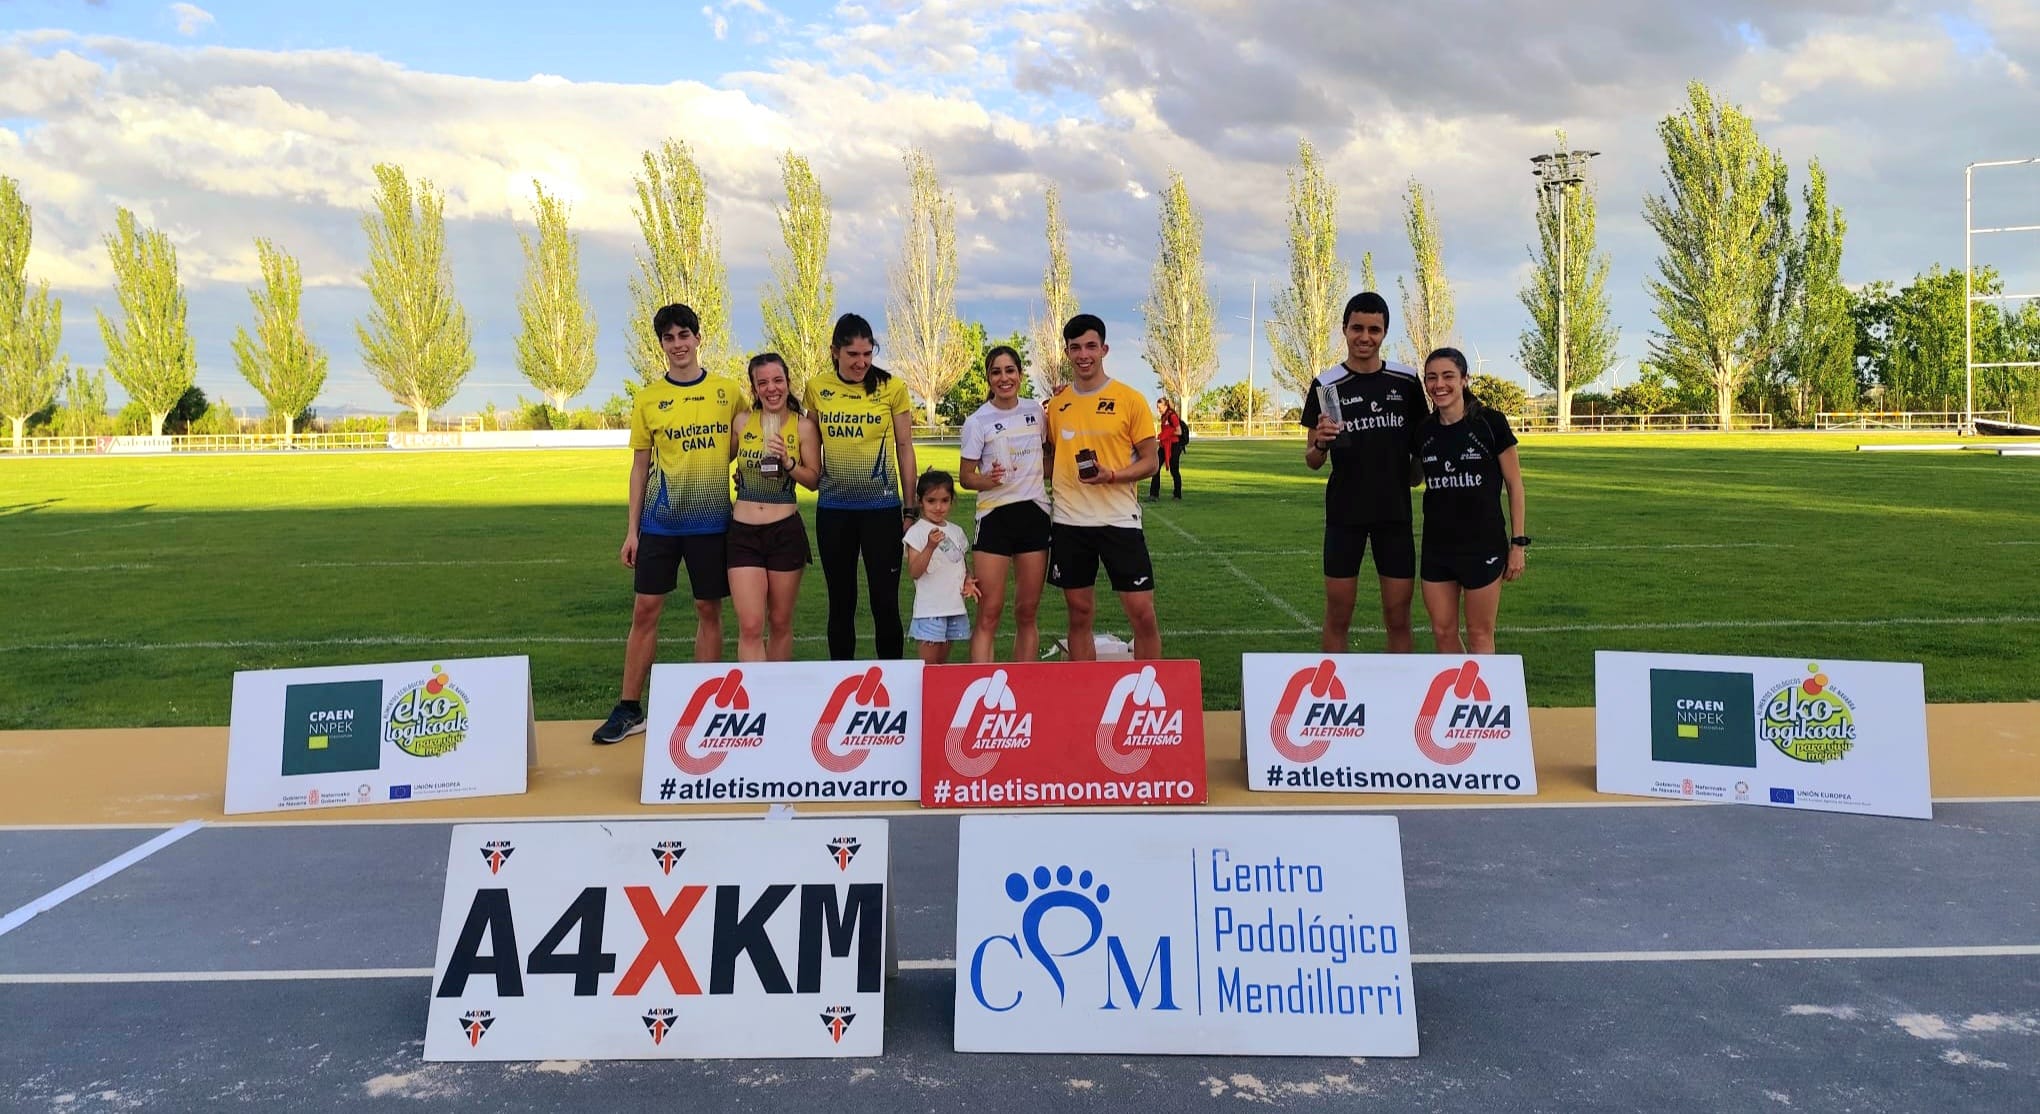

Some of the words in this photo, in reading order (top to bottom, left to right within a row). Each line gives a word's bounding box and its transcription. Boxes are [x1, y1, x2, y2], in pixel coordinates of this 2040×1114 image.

[1097, 401, 1116, 412] PA
[1025, 416, 1036, 424] PA
[665, 421, 729, 440] Valdizarbe
[828, 426, 864, 438] GANA
[682, 436, 716, 452] GANA
[739, 448, 762, 459] Valdi
[1676, 699, 1724, 712] CPAEN
[310, 709, 354, 722] CPAEN
[1304, 703, 1366, 726] FNA
[1448, 704, 1511, 729] FNA
[1678, 711, 1724, 724] NNPEK
[310, 722, 353, 734] NNPEK
[384, 712, 469, 746] logikoak
[704, 712, 767, 737] FNA
[846, 710, 908, 735] FNA
[976, 712, 1032, 738] FNA
[1126, 710, 1183, 735] FNA
[1300, 726, 1365, 738] ATLETISMO
[1445, 729, 1512, 740] ATLETISMO
[1760, 716, 1856, 749] logikoak
[698, 736, 764, 749] ATLETISMO
[840, 734, 905, 746] ATLETISMO
[972, 738, 1032, 750] ATLETISMO
[1123, 734, 1183, 746] ATLETISMO
[1267, 764, 1521, 790] #atletismonavarro
[660, 777, 908, 800] #atletismonavarro
[934, 778, 1194, 803] #atletismonavarro
[1797, 790, 1819, 798] UNIÓN
[1820, 792, 1852, 800] EUROPEA
[486, 840, 511, 848] A4XKM
[657, 840, 682, 848] A4XKM
[832, 836, 856, 844] A4XKM
[1212, 848, 1324, 893] Centro
[436, 883, 883, 998] A4XKM
[1214, 906, 1398, 964] Podológico
[1217, 966, 1403, 1016] Mendillorri
[465, 1010, 491, 1018] A4XKM
[648, 1008, 674, 1016] A4XKM
[826, 1006, 852, 1014] A4XKM
